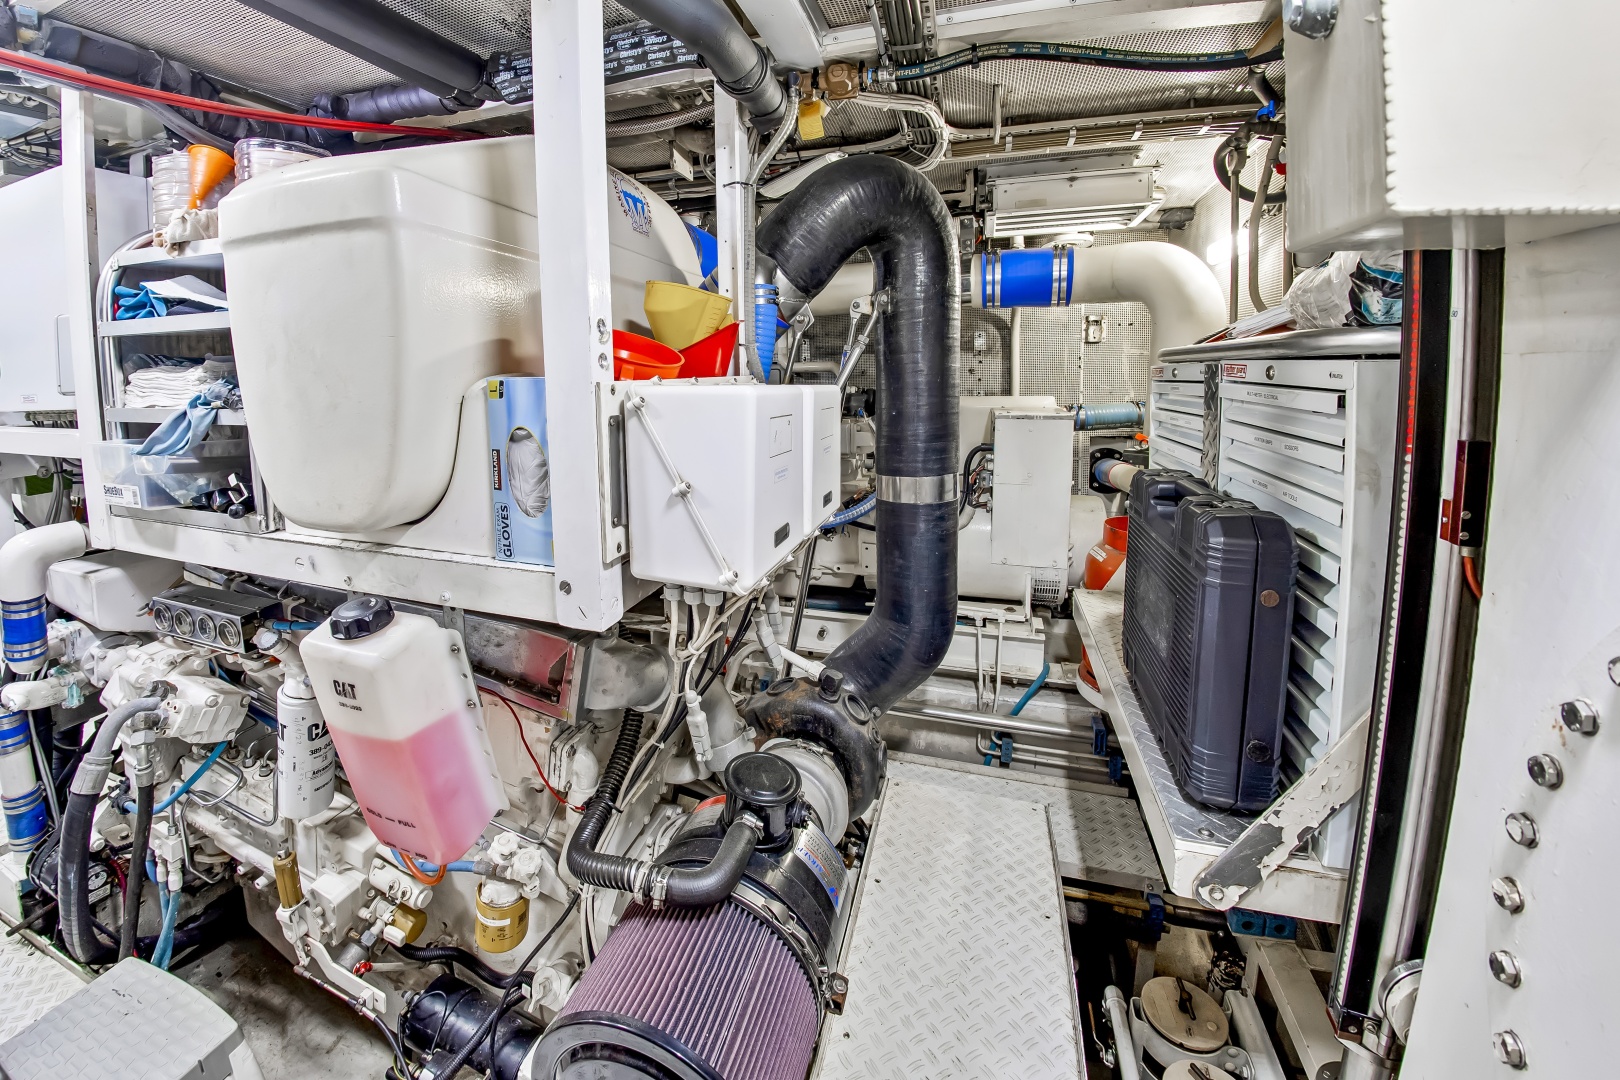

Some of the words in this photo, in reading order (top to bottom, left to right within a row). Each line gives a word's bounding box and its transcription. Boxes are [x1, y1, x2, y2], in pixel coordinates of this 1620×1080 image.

[644, 35, 667, 46] Christy's
[619, 48, 643, 58] Christy's
[648, 50, 671, 60] Christy's
[1058, 46, 1103, 56] TRIDENT-FLEX
[677, 53, 698, 62] Christy's
[624, 61, 648, 72] Christy's
[501, 85, 521, 96] Christy's
[489, 385, 498, 393] L
[1287, 492, 1298, 502] TOOLS
[500, 505, 513, 558] GLOVES
[332, 679, 358, 701] CAT
[397, 819, 416, 829] FULL
[382, 839, 397, 849] LOW
